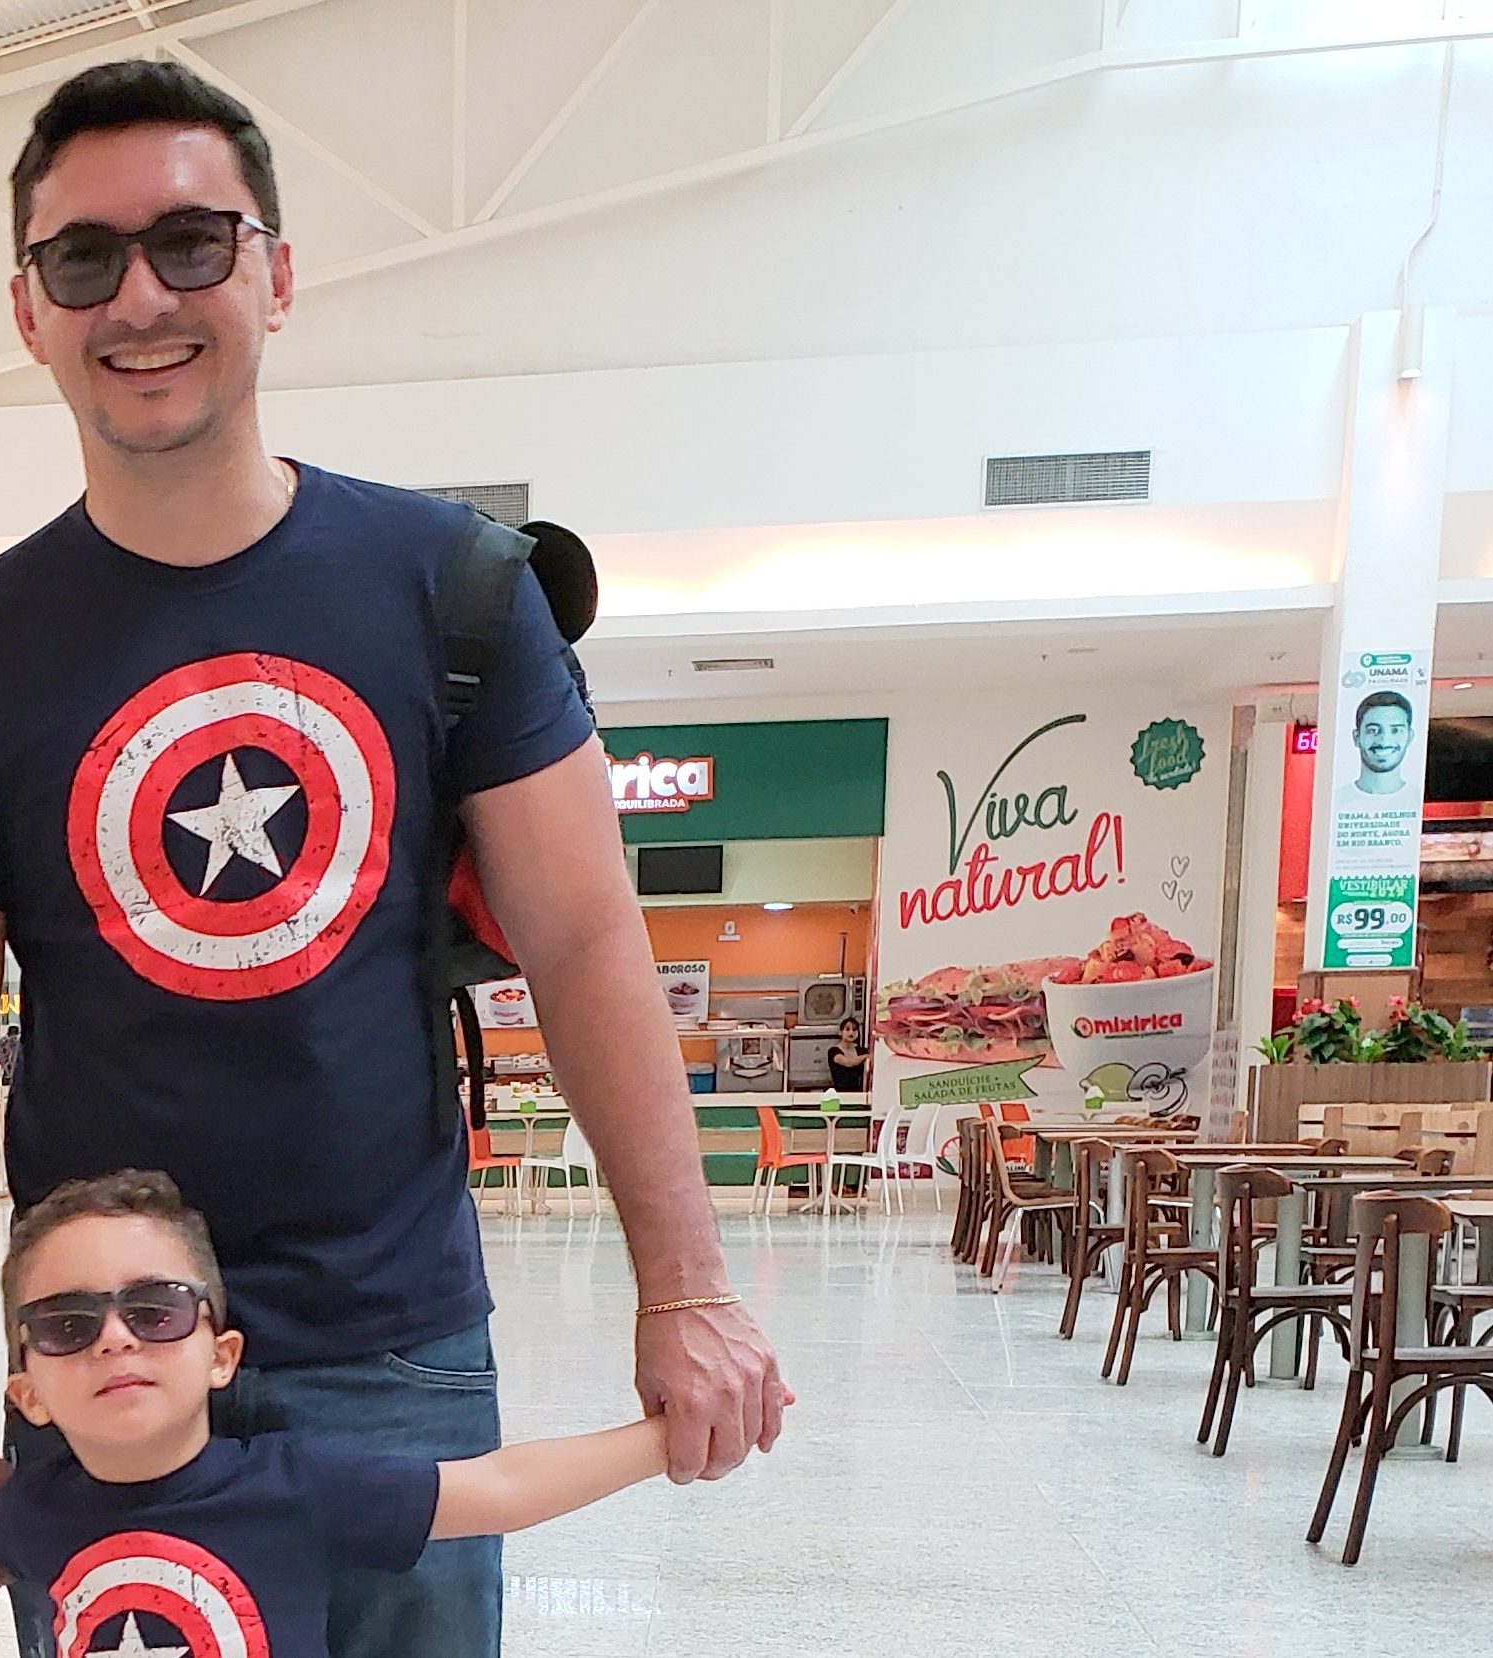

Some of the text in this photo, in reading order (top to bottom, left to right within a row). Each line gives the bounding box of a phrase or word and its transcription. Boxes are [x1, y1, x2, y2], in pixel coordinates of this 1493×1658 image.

[1369, 667, 1409, 676] UNAMA
[936, 713, 1087, 876] Viva
[1338, 821, 1401, 829] UNIVERSIDADE
[899, 811, 1126, 929] natural!
[1339, 879, 1408, 891] VESTIBULAR
[1094, 1013, 1182, 1035] mixirica
[914, 1081, 1017, 1102] SALADA DE FRUTAS
